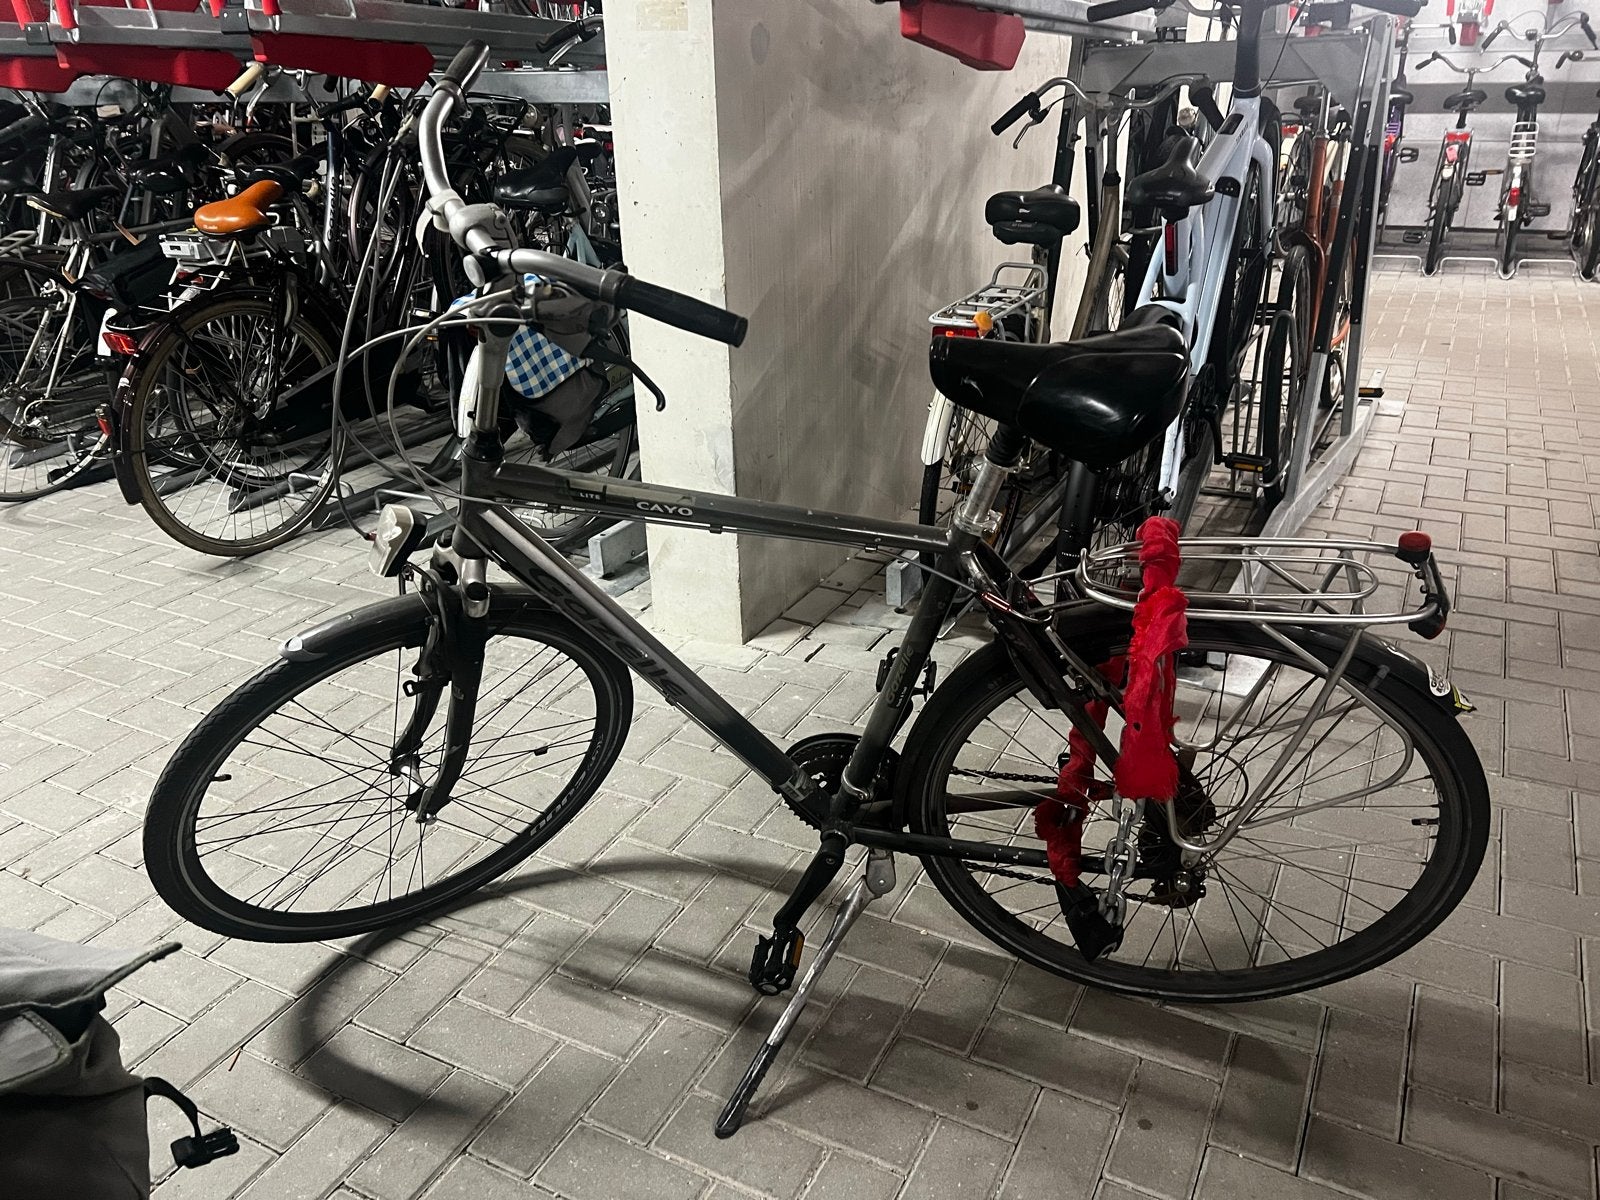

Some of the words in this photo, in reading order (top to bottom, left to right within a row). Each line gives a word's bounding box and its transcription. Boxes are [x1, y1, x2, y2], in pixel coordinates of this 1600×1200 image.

[579, 491, 601, 500] LITE
[636, 501, 694, 517] CAYO
[529, 568, 688, 697] Gazelle
[885, 644, 914, 704] Gazelle
